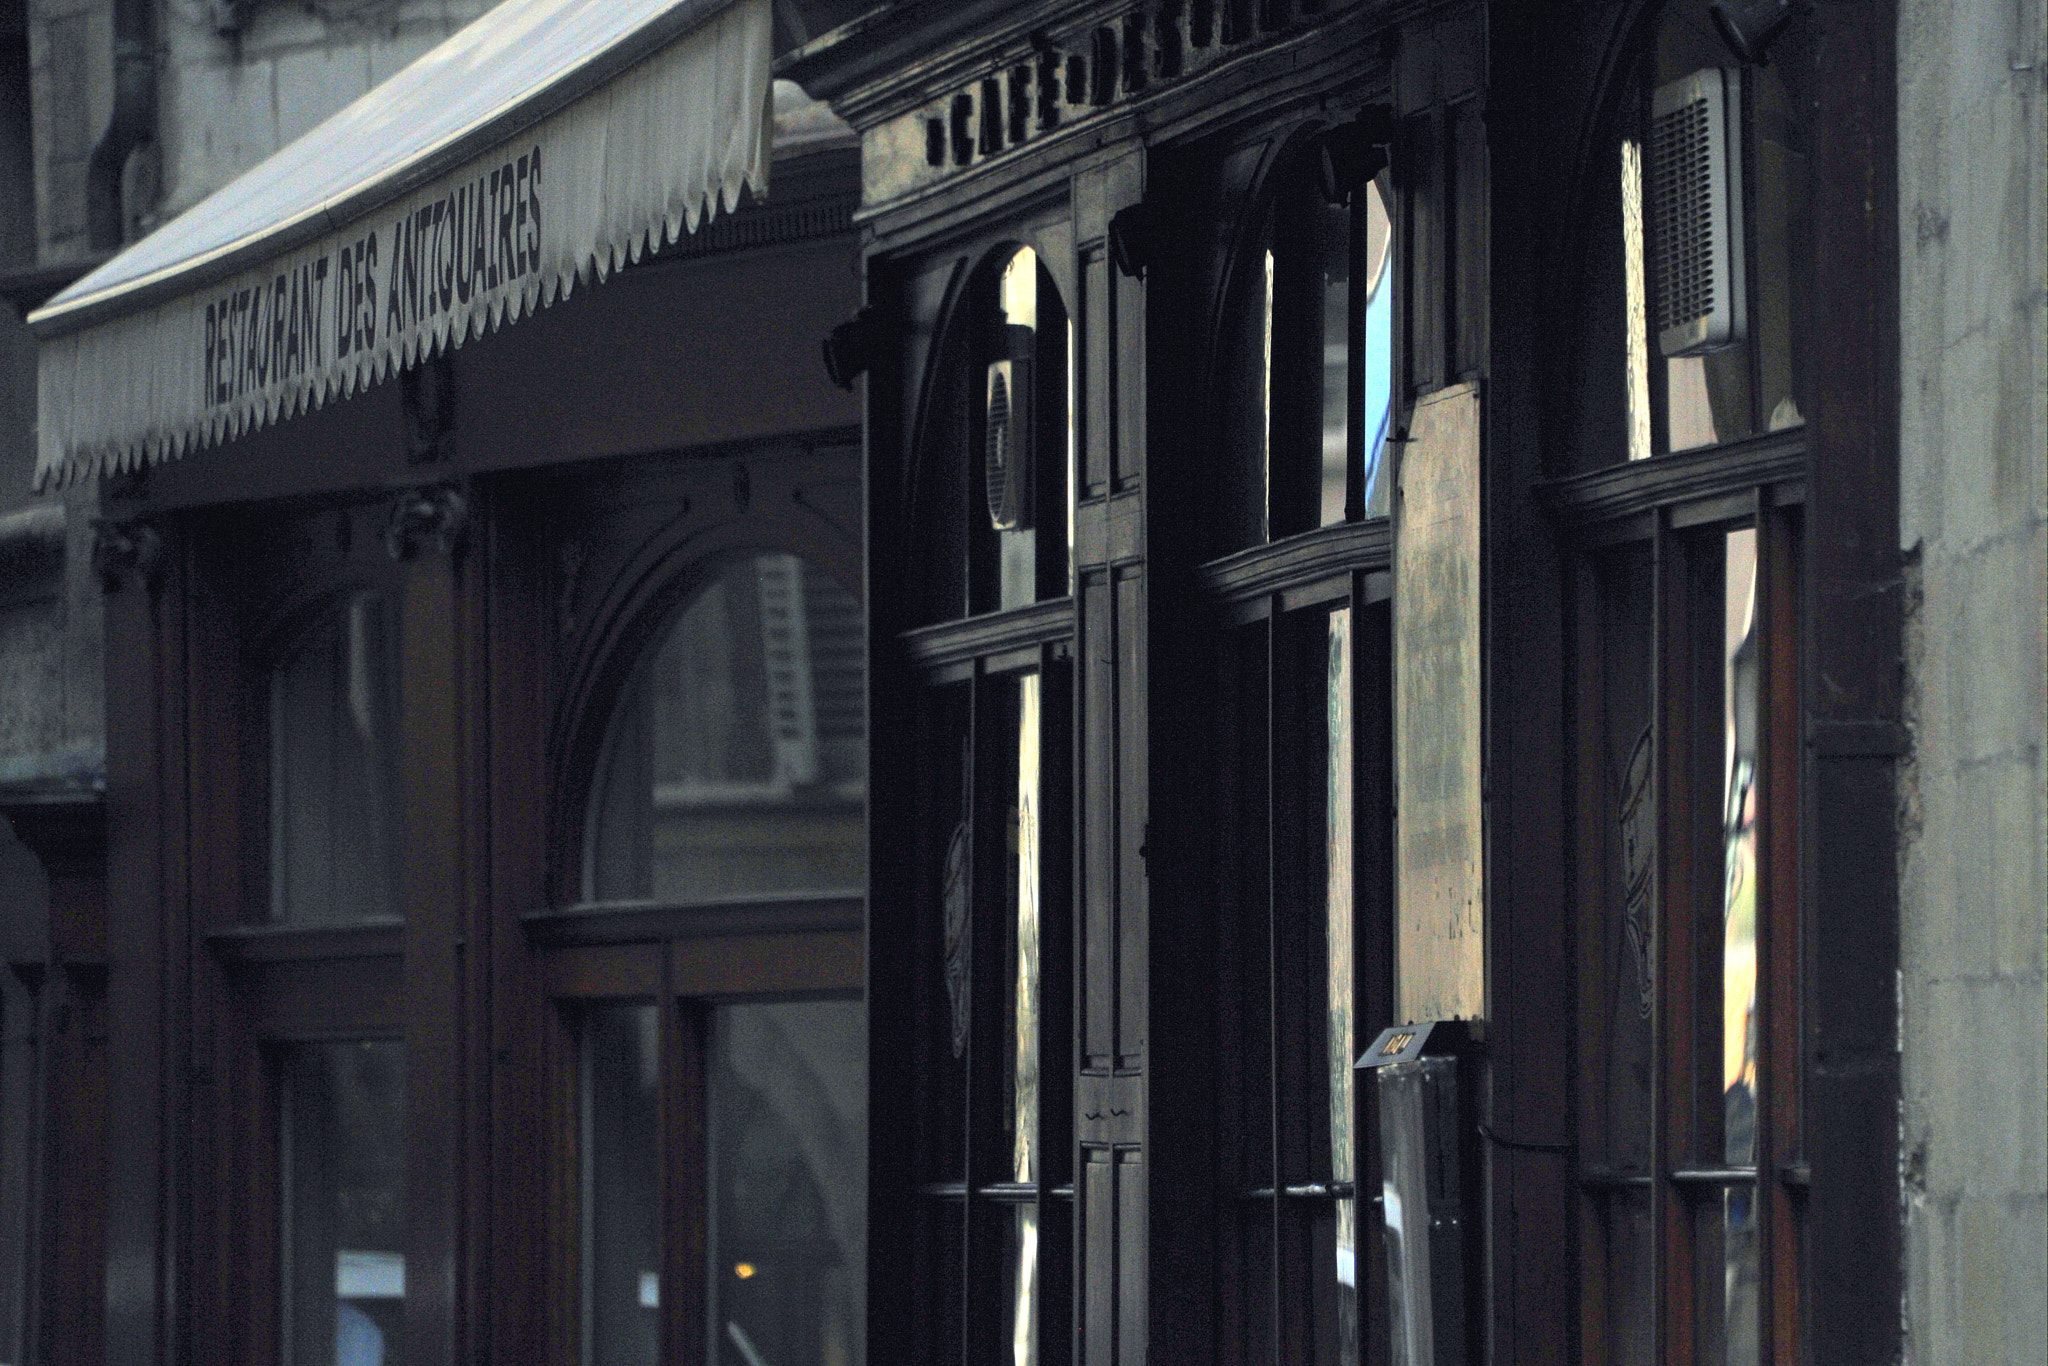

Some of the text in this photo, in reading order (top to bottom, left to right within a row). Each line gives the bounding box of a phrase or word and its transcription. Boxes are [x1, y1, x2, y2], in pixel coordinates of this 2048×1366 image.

[204, 145, 542, 410] RESTAURANT DES ANTIQUAIRES
